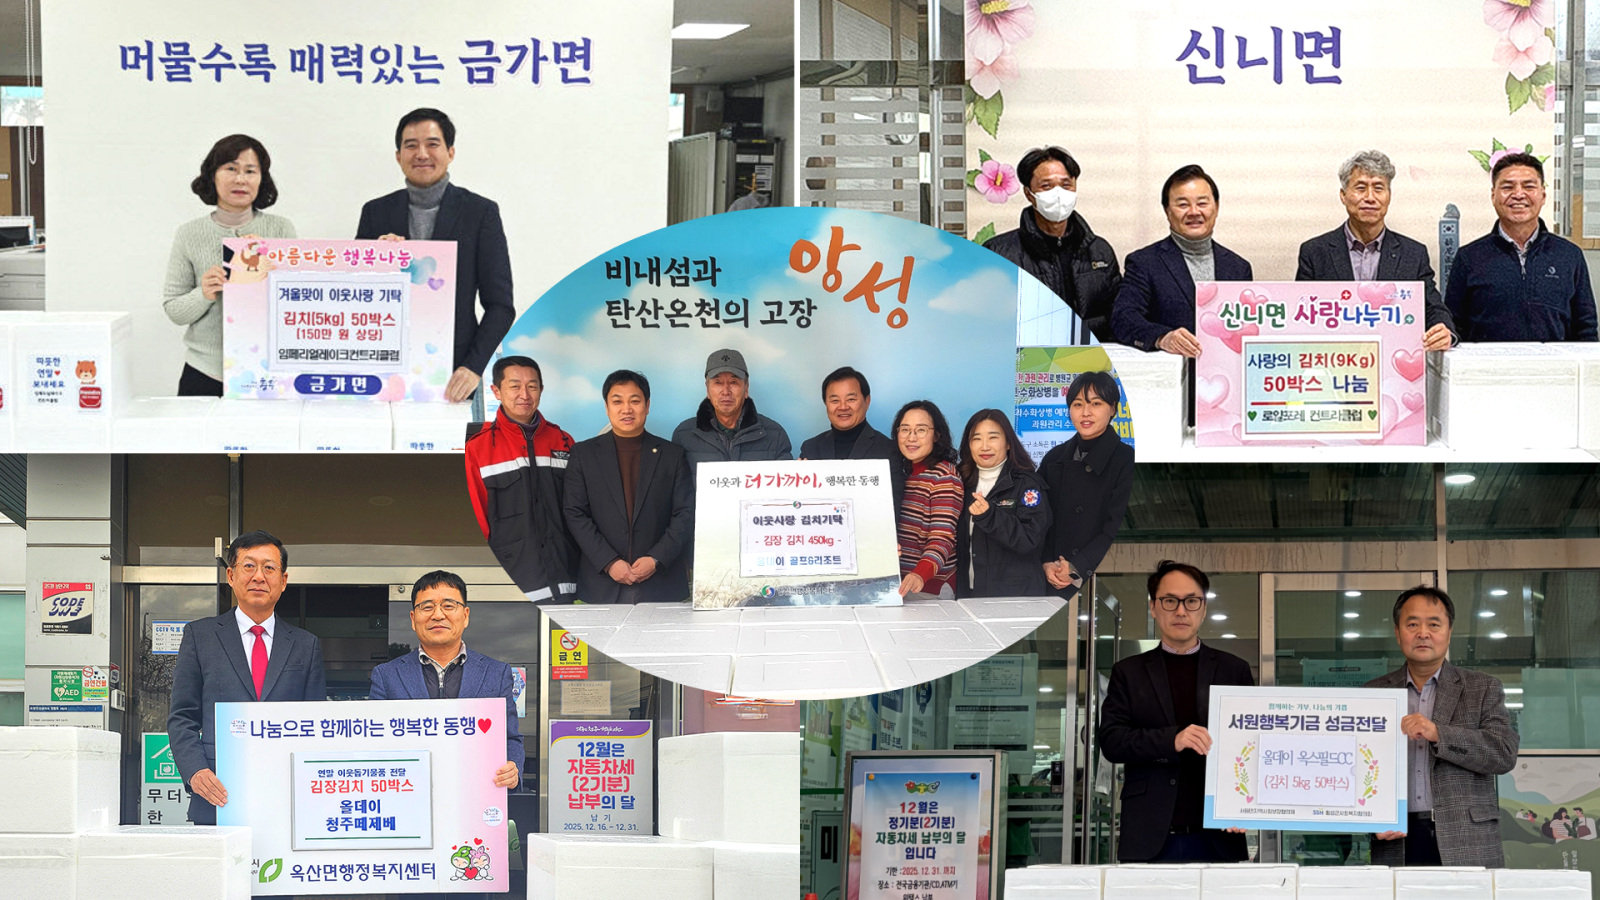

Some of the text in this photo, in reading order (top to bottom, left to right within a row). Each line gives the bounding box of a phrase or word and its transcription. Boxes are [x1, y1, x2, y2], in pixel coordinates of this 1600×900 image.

[119, 37, 593, 85] 머물수록 매력있는 금가면
[1176, 26, 1343, 85] 신니면
[268, 248, 412, 268] 아름다운 행복나눔
[605, 256, 722, 287] 비내섬과
[789, 226, 915, 330] 앙성
[278, 287, 402, 303] 겨울맞이 이웃사랑 기탁
[351, 311, 396, 327] 50박스
[605, 298, 818, 329] 탄산온천의 고장
[1220, 302, 1286, 328] 신니면
[338, 329, 349, 341] 원
[355, 329, 383, 341] 상당)
[1248, 353, 1376, 369] 사랑의 김치(9Kg)
[309, 376, 368, 393] 금가면
[1263, 375, 1369, 394] 50박스 나눔
[709, 476, 742, 488] 이웃과
[744, 473, 761, 489] 더
[825, 475, 857, 487] 행복한
[858, 475, 880, 487] 동행
[752, 514, 844, 526] 이웃사랑 김치기탁
[763, 535, 782, 546] 김장
[786, 535, 805, 546] 김치
[808, 536, 834, 546] 450kg
[789, 555, 842, 566] 골프&리조트
[52, 597, 86, 607] CODE
[250, 719, 316, 739] 나눔으로
[320, 718, 385, 738] 함께하는
[389, 717, 439, 737] 행복한
[443, 716, 477, 736] 동행
[1228, 713, 1388, 733] 서원행복기금 성금전달
[577, 741, 625, 757] 12월은
[1261, 749, 1353, 766] 올데이 옥스필드CC
[317, 768, 406, 777] 연말 이웃돕기물품 전달
[567, 759, 635, 775] 자동차세
[310, 779, 414, 794] 김장김치 50박스
[572, 775, 630, 793] (2기분)
[1264, 775, 1350, 791] (김치 5kg 50박스)
[339, 799, 382, 815] 올데이
[568, 793, 636, 809] 납부의 달
[899, 801, 939, 814] 12월은
[325, 816, 396, 832] 청주떼제베
[564, 823, 584, 832] 2025.
[888, 816, 955, 830] 정기분(2기분)
[875, 831, 966, 845] 자동차세 납부의 달
[905, 846, 937, 860] 입니다
[289, 862, 437, 882] 옥산면행정복지센터
